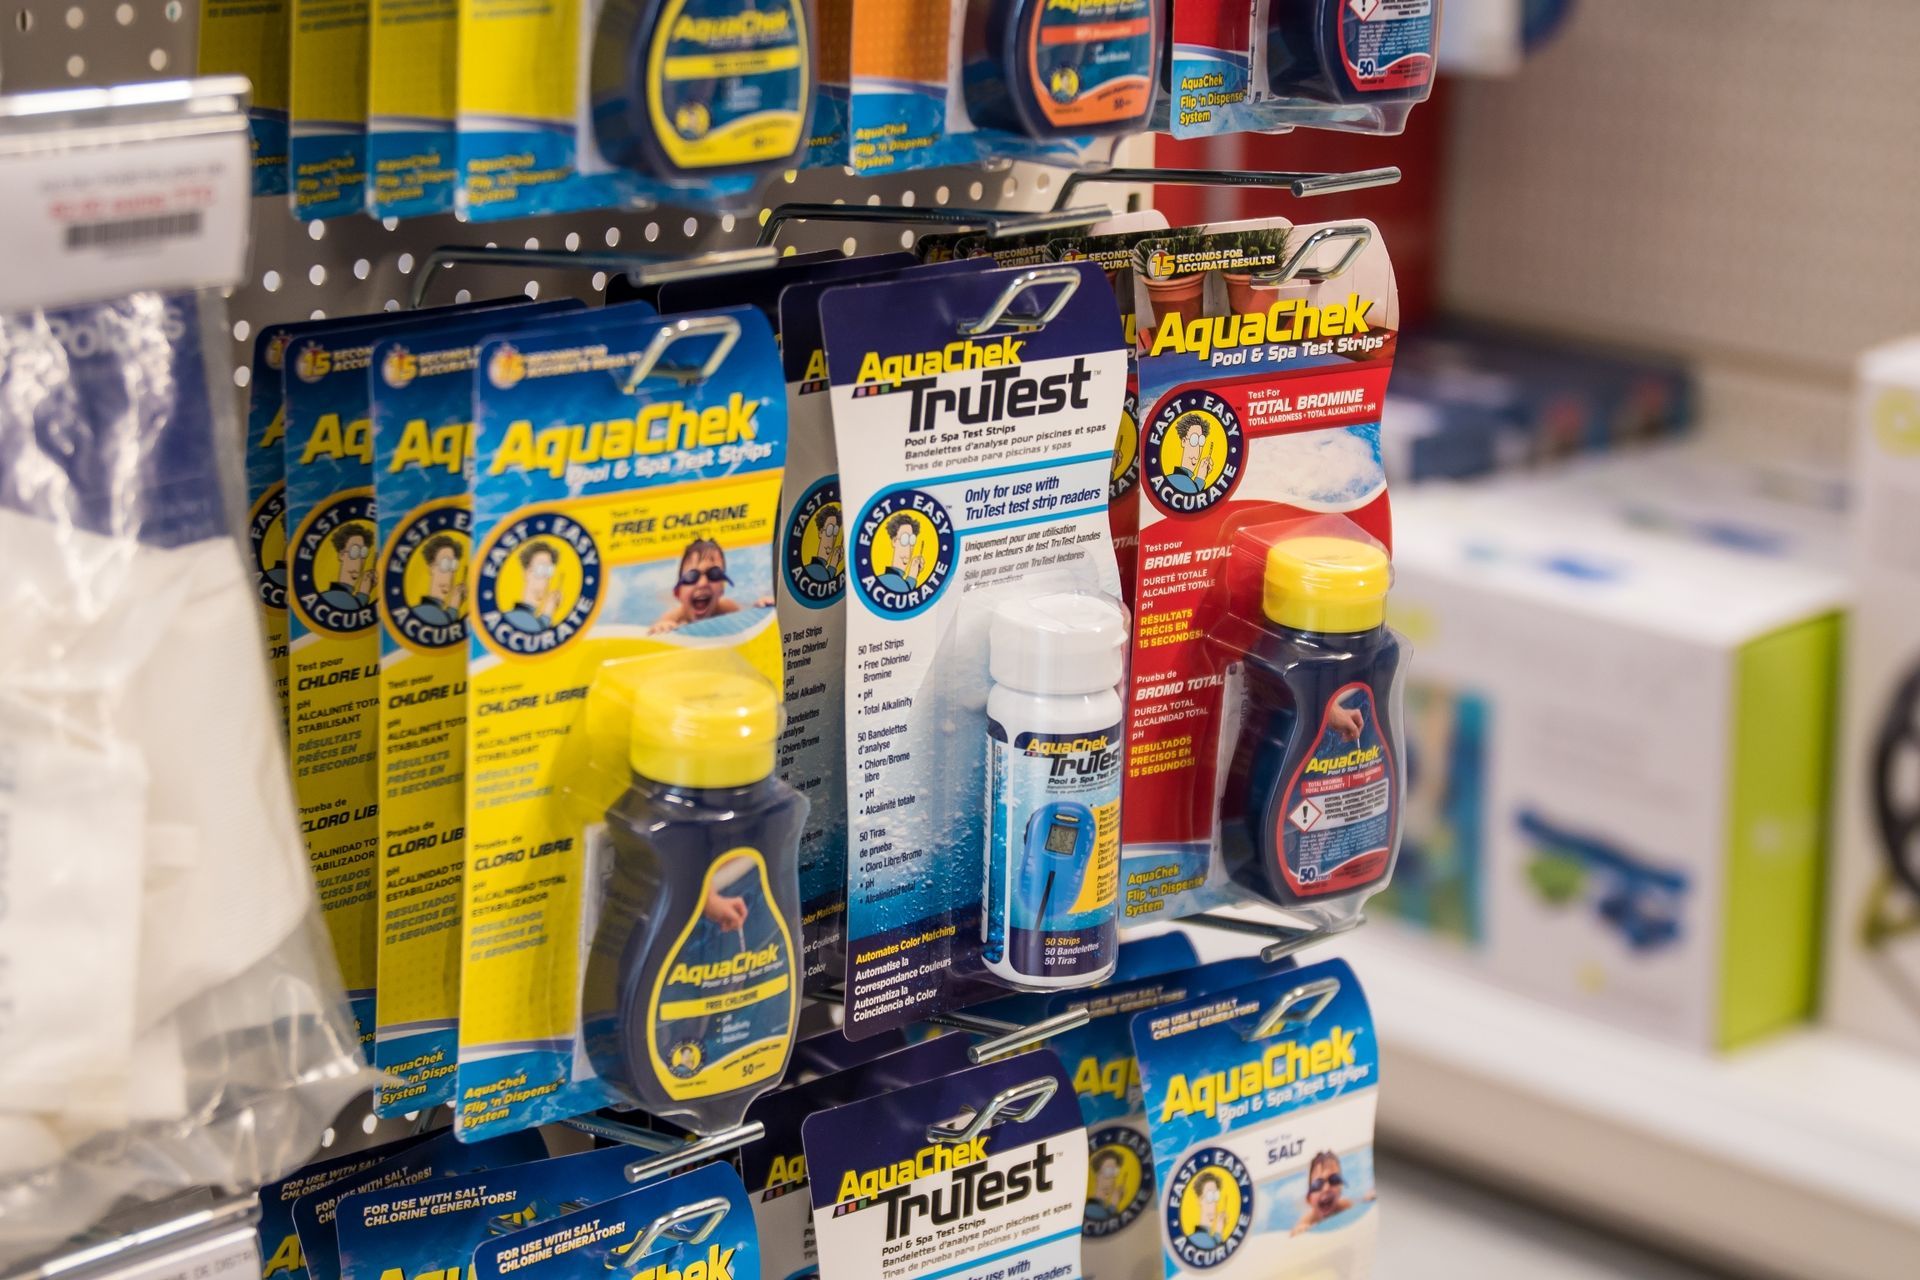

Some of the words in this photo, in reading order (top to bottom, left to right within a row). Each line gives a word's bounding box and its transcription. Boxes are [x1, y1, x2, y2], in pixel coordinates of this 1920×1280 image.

[1359, 61, 1374, 77] 50
[1180, 75, 1224, 91] AquaChek
[1180, 95, 1196, 108] Flip
[1179, 110, 1211, 124] System
[1150, 253, 1176, 276] 15
[1177, 253, 1216, 264] SECONDS
[1219, 250, 1243, 259] FOR
[1177, 260, 1230, 274] ACCURATE
[1231, 256, 1275, 267] RESULTS!
[1150, 292, 1373, 360] AquaChek
[856, 336, 1023, 387] AquaChek
[1212, 349, 1246, 367] Pool
[1251, 347, 1263, 361] &
[1268, 347, 1296, 361] Spa
[1302, 341, 1333, 356] Test
[909, 358, 1092, 432] TruTest
[1248, 391, 1264, 399] Test
[1267, 389, 1280, 398] For
[1248, 398, 1292, 416] TOTAL
[1296, 389, 1364, 409] BROMINE
[1150, 399, 1182, 445] FAST
[1203, 395, 1240, 437] EASY
[1248, 417, 1268, 426] TOTAL
[1269, 413, 1302, 425] HARDNESS
[1307, 409, 1326, 418] TOTAL
[1327, 405, 1363, 417] ALKALINITY
[1368, 402, 1376, 411] pH
[489, 392, 760, 479] AquaChek
[905, 438, 926, 447] Pool
[941, 433, 959, 444] Spa
[963, 430, 983, 439] Test
[986, 425, 1016, 437] Strips
[905, 446, 962, 459] Bandelettes
[965, 439, 1009, 452] d'analyse
[1011, 435, 1034, 446] pour
[1036, 430, 1072, 442] piscines
[1086, 424, 1106, 434] spas
[965, 487, 990, 503] Only
[994, 483, 1009, 499] for
[1013, 482, 1032, 495] use
[1036, 476, 1059, 491] with
[1150, 463, 1237, 510] ACCURATE
[967, 504, 1006, 520] TruTest
[1009, 499, 1030, 513] test
[1032, 494, 1057, 510] strip
[1060, 488, 1101, 505] readers
[610, 519, 656, 538] FREE
[663, 504, 749, 530] CHLORINE
[860, 499, 893, 546] FAST
[912, 495, 950, 534] EASY
[484, 521, 528, 578] FAST
[553, 517, 599, 566] EASY
[1145, 544, 1161, 553] Test
[1164, 541, 1183, 551] pour
[1145, 552, 1192, 571] BROME
[1196, 545, 1233, 562] TOTAL
[861, 561, 948, 609] ACCURATE
[1143, 574, 1175, 587] DURETÉ
[1177, 569, 1208, 580] TOTALE
[1143, 584, 1186, 598] ALCALINITÉ
[1188, 579, 1216, 592] TOTALE
[1142, 601, 1153, 610] pH
[483, 597, 594, 653] ACCURATE
[1141, 609, 1193, 625] RÉSULTATS
[1140, 623, 1173, 637] PRÉCIS
[1176, 621, 1188, 630] EN
[858, 645, 867, 655] 50
[869, 642, 882, 653] Test
[885, 639, 904, 650] Strips
[1140, 640, 1148, 649] 15
[864, 660, 879, 670] Free
[881, 652, 912, 665] Chlorine/
[864, 670, 892, 682] Bromine
[1137, 673, 1165, 684] Prueba
[1167, 670, 1177, 678] de
[864, 689, 873, 701] pH
[1136, 681, 1184, 701] BROMO
[1187, 674, 1224, 691] TOTAL
[864, 704, 880, 715] Total
[882, 697, 913, 712] Alkalinity
[1134, 705, 1168, 717] DUREZA
[1170, 699, 1194, 710] TOTAL
[1134, 712, 1184, 728] ALCALINIDAD
[1186, 707, 1209, 717] TOTAL
[858, 732, 866, 742] 50
[868, 723, 907, 739] Bandelettes
[1132, 731, 1144, 740] pH
[858, 740, 891, 755] d'analyse
[1027, 735, 1108, 754] AquaChek
[1131, 736, 1192, 755] RESULTADOS
[865, 751, 910, 770] Chlore/Brome
[1130, 768, 1139, 777] 15
[1142, 757, 1195, 776] SEGUNDOS!
[1131, 750, 1177, 766] PRECISOS
[1179, 747, 1191, 757] EN
[1306, 745, 1380, 775] AquaChek
[865, 771, 880, 783] libre
[865, 789, 874, 801] pH
[866, 797, 896, 815] Alcalinité
[898, 794, 915, 806] totale
[860, 831, 868, 842] 50
[870, 828, 886, 839] Tiras
[860, 850, 867, 858] de
[870, 842, 892, 856] prueba
[1128, 864, 1179, 885] AquaChek
[1127, 889, 1146, 902] Flip
[1126, 900, 1164, 917] System
[856, 945, 899, 965] Automates
[900, 937, 920, 950] Color
[922, 925, 956, 943] Matching
[1045, 937, 1056, 946] 50
[1058, 937, 1080, 946] Strips
[1045, 948, 1056, 956] 50
[1057, 942, 1099, 955] Bandelettes
[668, 943, 780, 987] AquaChek
[855, 961, 900, 981] Automatise
[902, 957, 909, 966] la
[1045, 958, 1056, 966] 50
[1058, 956, 1076, 965] Tiras
[855, 968, 918, 996] Correspondance
[920, 958, 951, 975] Couleurs
[854, 989, 900, 1010] Automatiza
[901, 986, 908, 995] la
[854, 1000, 903, 1022] Coincidencia
[905, 996, 915, 1006] de
[916, 989, 937, 1001] Color
[1161, 1026, 1357, 1124] AquaChek
[464, 1073, 527, 1100] AquaChek
[462, 1107, 510, 1127] System
[463, 1100, 488, 1116] Flip
[1267, 1139, 1305, 1166] SALT
[837, 1135, 991, 1204] AquaChek
[1170, 1159, 1197, 1208] FAST
[1214, 1150, 1250, 1188] EASY
[363, 1203, 384, 1217] FOR
[386, 1198, 417, 1212] USE
[419, 1192, 453, 1209] WITH
[455, 1186, 487, 1202] SALT
[886, 1143, 1054, 1244] TruTest
[365, 1205, 429, 1228] CHLORINE
[431, 1190, 518, 1217] GENERATORS!
[1173, 1213, 1250, 1267] ACCURATE
